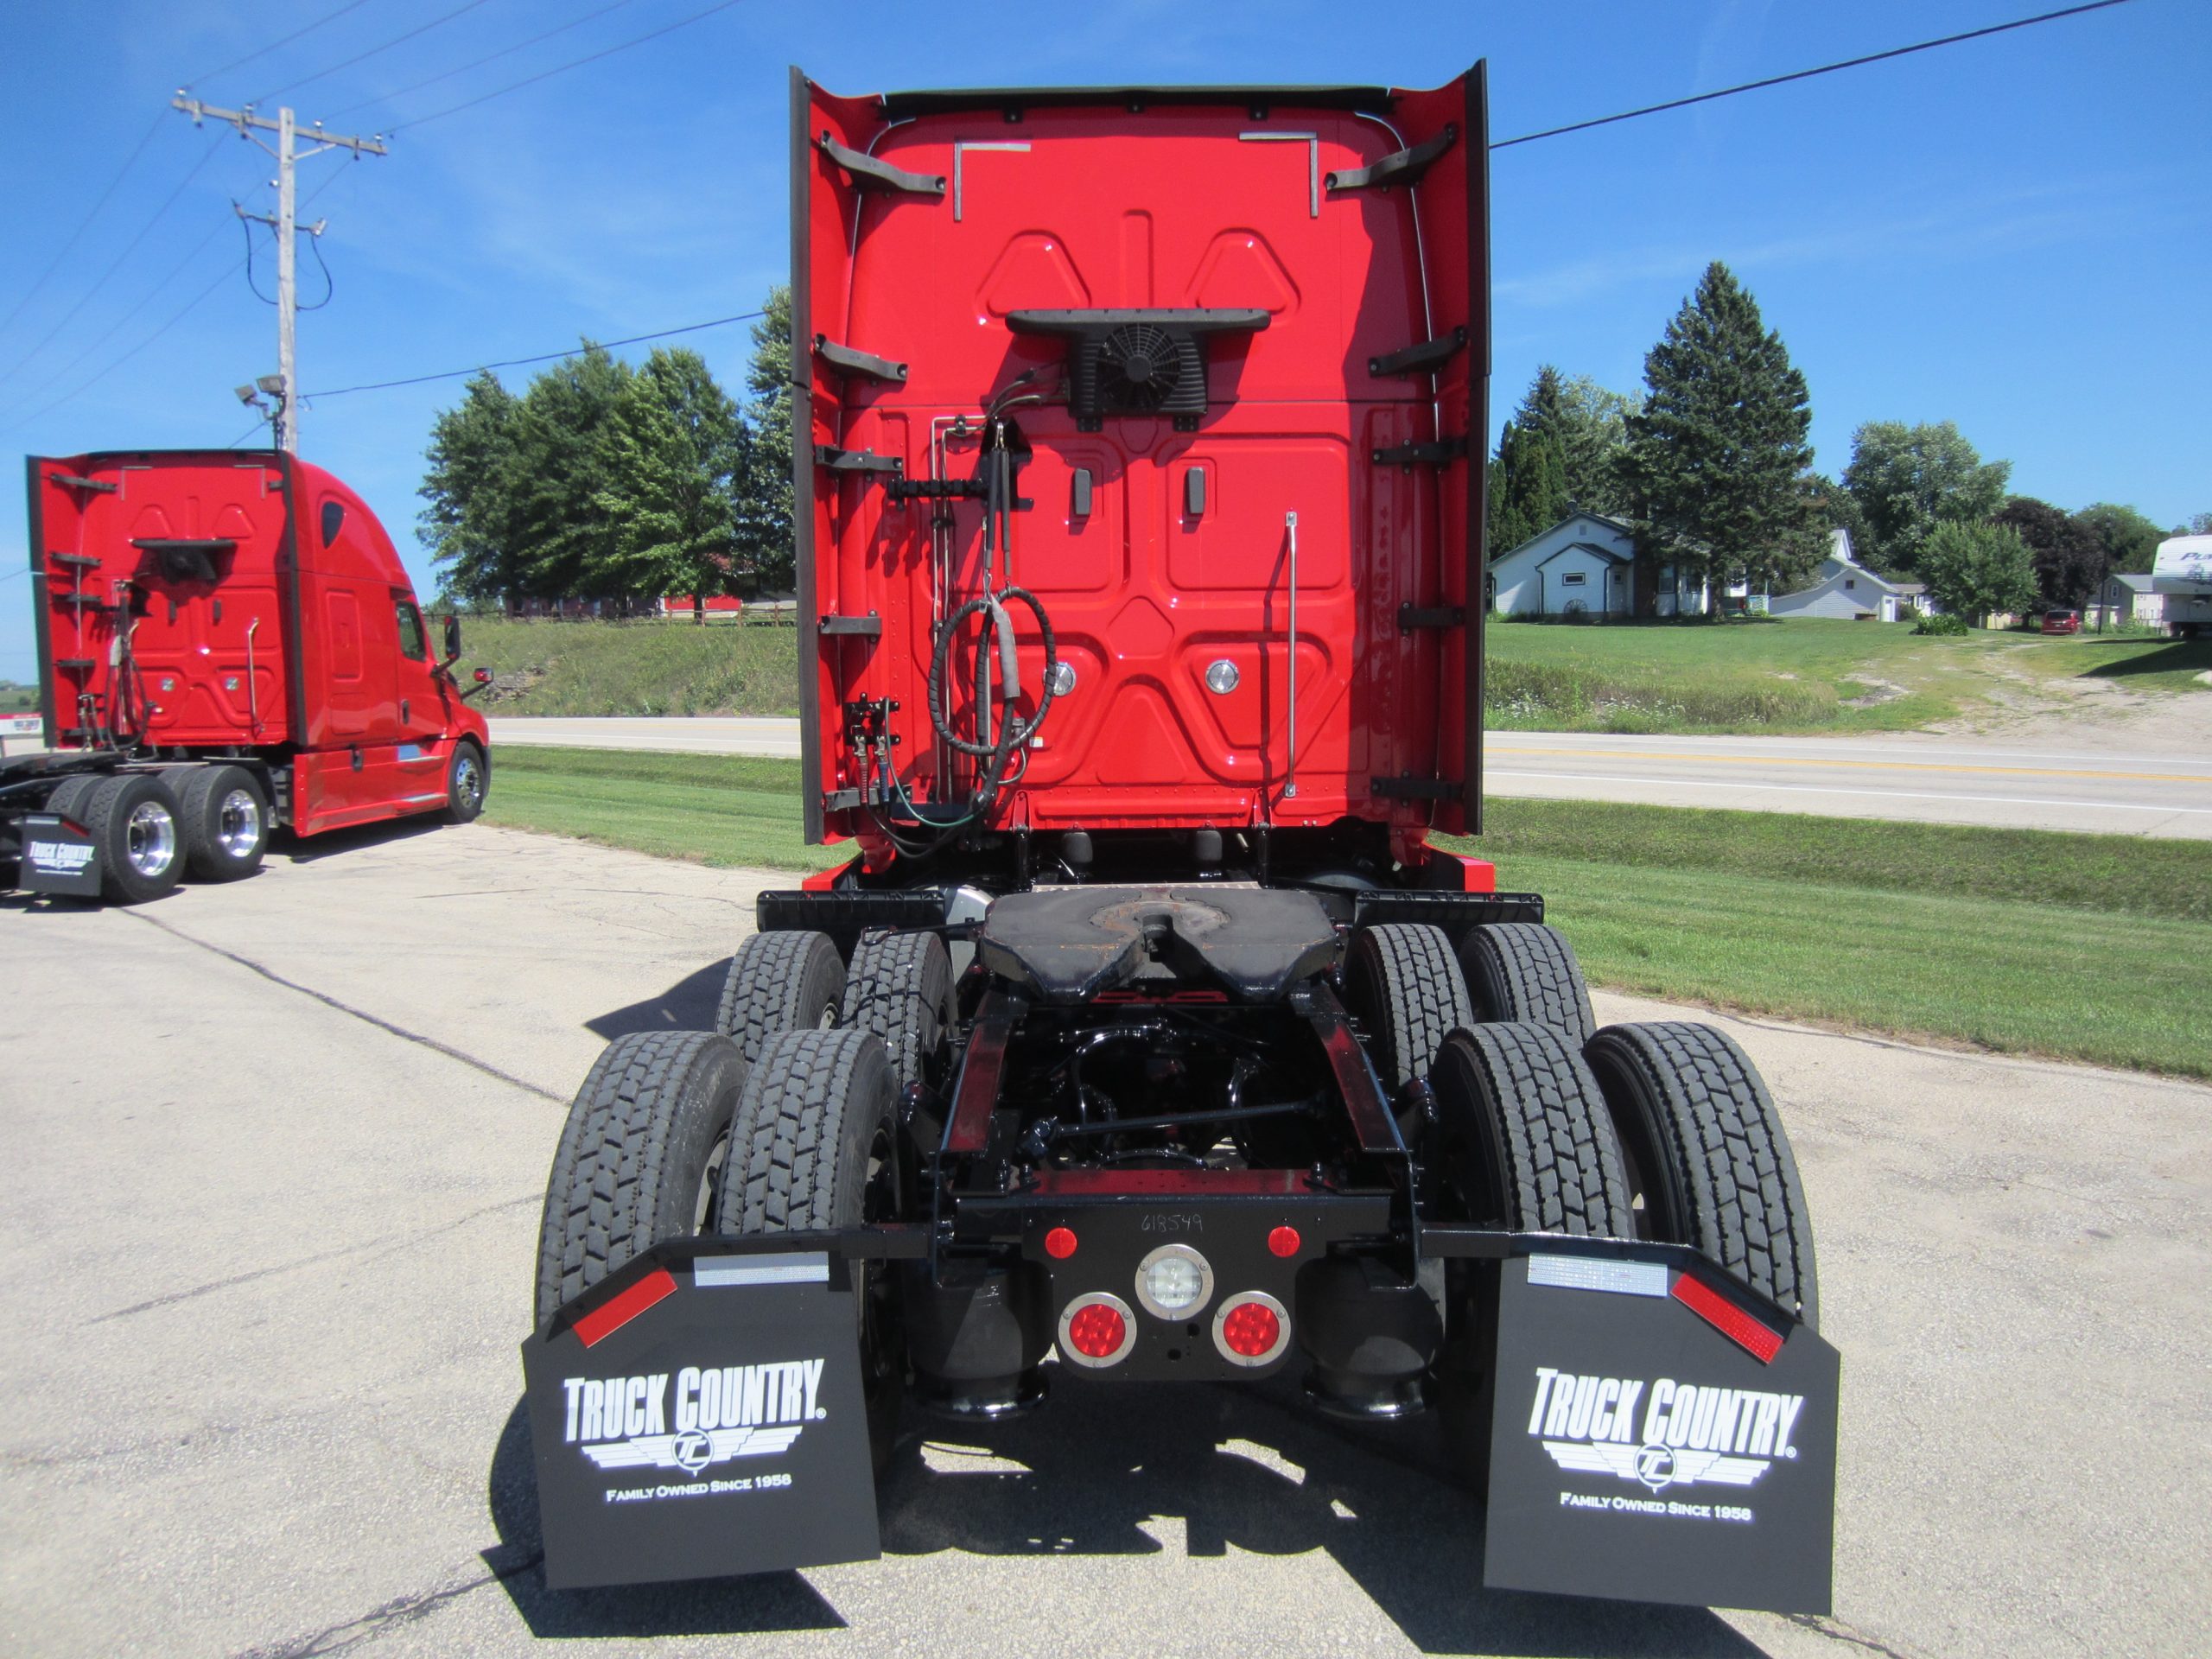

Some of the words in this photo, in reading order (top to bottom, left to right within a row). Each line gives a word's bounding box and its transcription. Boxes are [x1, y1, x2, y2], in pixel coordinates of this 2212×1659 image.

[1141, 1213, 1203, 1232] 618549
[563, 1373, 669, 1442] TRUCK
[1527, 1366, 1644, 1443] TRUCK
[606, 1489, 654, 1502] FAMILY
[656, 1482, 709, 1497] OWNED
[710, 1478, 753, 1492] SINCE
[754, 1473, 792, 1488] 1958
[1560, 1491, 1612, 1509] FAMILY
[1611, 1496, 1667, 1514] OWNED
[1667, 1501, 1712, 1518] SINCE
[1714, 1504, 1752, 1522] 1958
